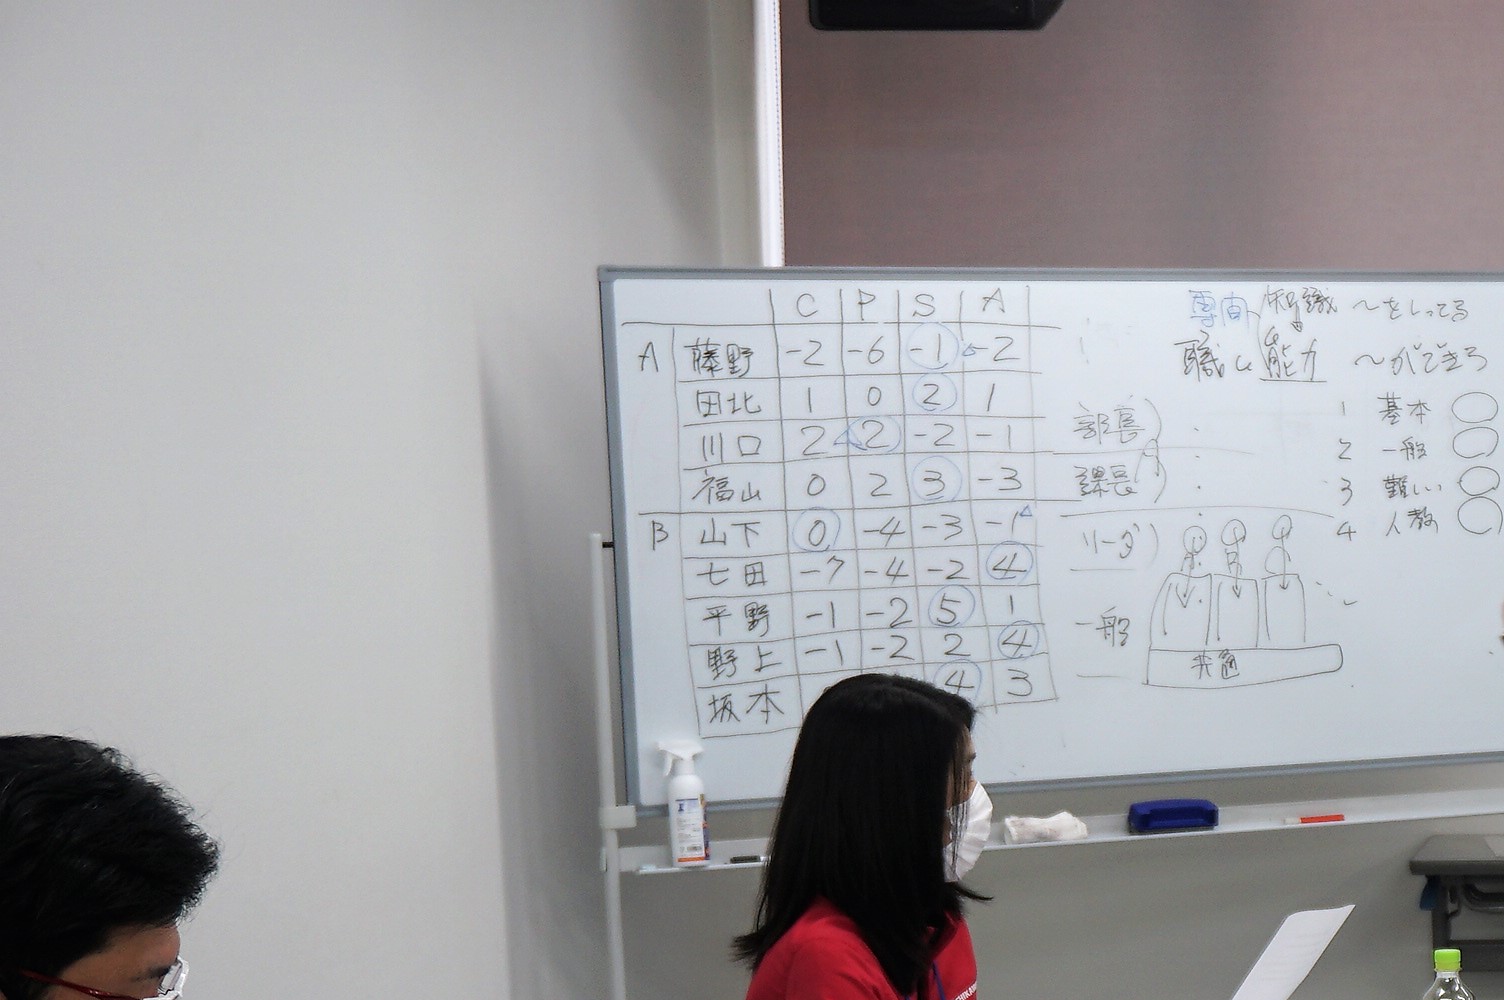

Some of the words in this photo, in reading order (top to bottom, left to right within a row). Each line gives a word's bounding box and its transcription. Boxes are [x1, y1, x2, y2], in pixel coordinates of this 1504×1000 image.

[797, 293, 818, 317] C
[858, 290, 876, 321] P
[912, 293, 936, 318] S
[982, 288, 1006, 313] A
[638, 342, 660, 372] A
[696, 390, 761, 417] 田北
[922, 382, 950, 406] 2
[1377, 392, 1432, 426] 基本
[701, 431, 761, 464] 川口
[800, 425, 827, 456] 2
[861, 419, 889, 449] 2
[1338, 438, 1352, 460] 2
[1382, 436, 1427, 461] 一般
[691, 468, 761, 502] 福山
[807, 473, 826, 498] 0
[870, 472, 892, 497] 2
[923, 468, 947, 497] 3
[978, 466, 1023, 490] -3
[1340, 477, 1353, 506] 3
[652, 520, 669, 551] B
[700, 518, 762, 547] 山下
[1337, 521, 1357, 541] 4
[696, 561, 765, 587] 七田
[991, 551, 1028, 579] 4
[702, 601, 771, 638] 平野
[933, 593, 958, 625] 5
[707, 646, 784, 681] 野上
[944, 634, 970, 656] 2
[1001, 629, 1032, 652] 4
[708, 684, 785, 724] 坂本
[1009, 669, 1032, 697] 3
